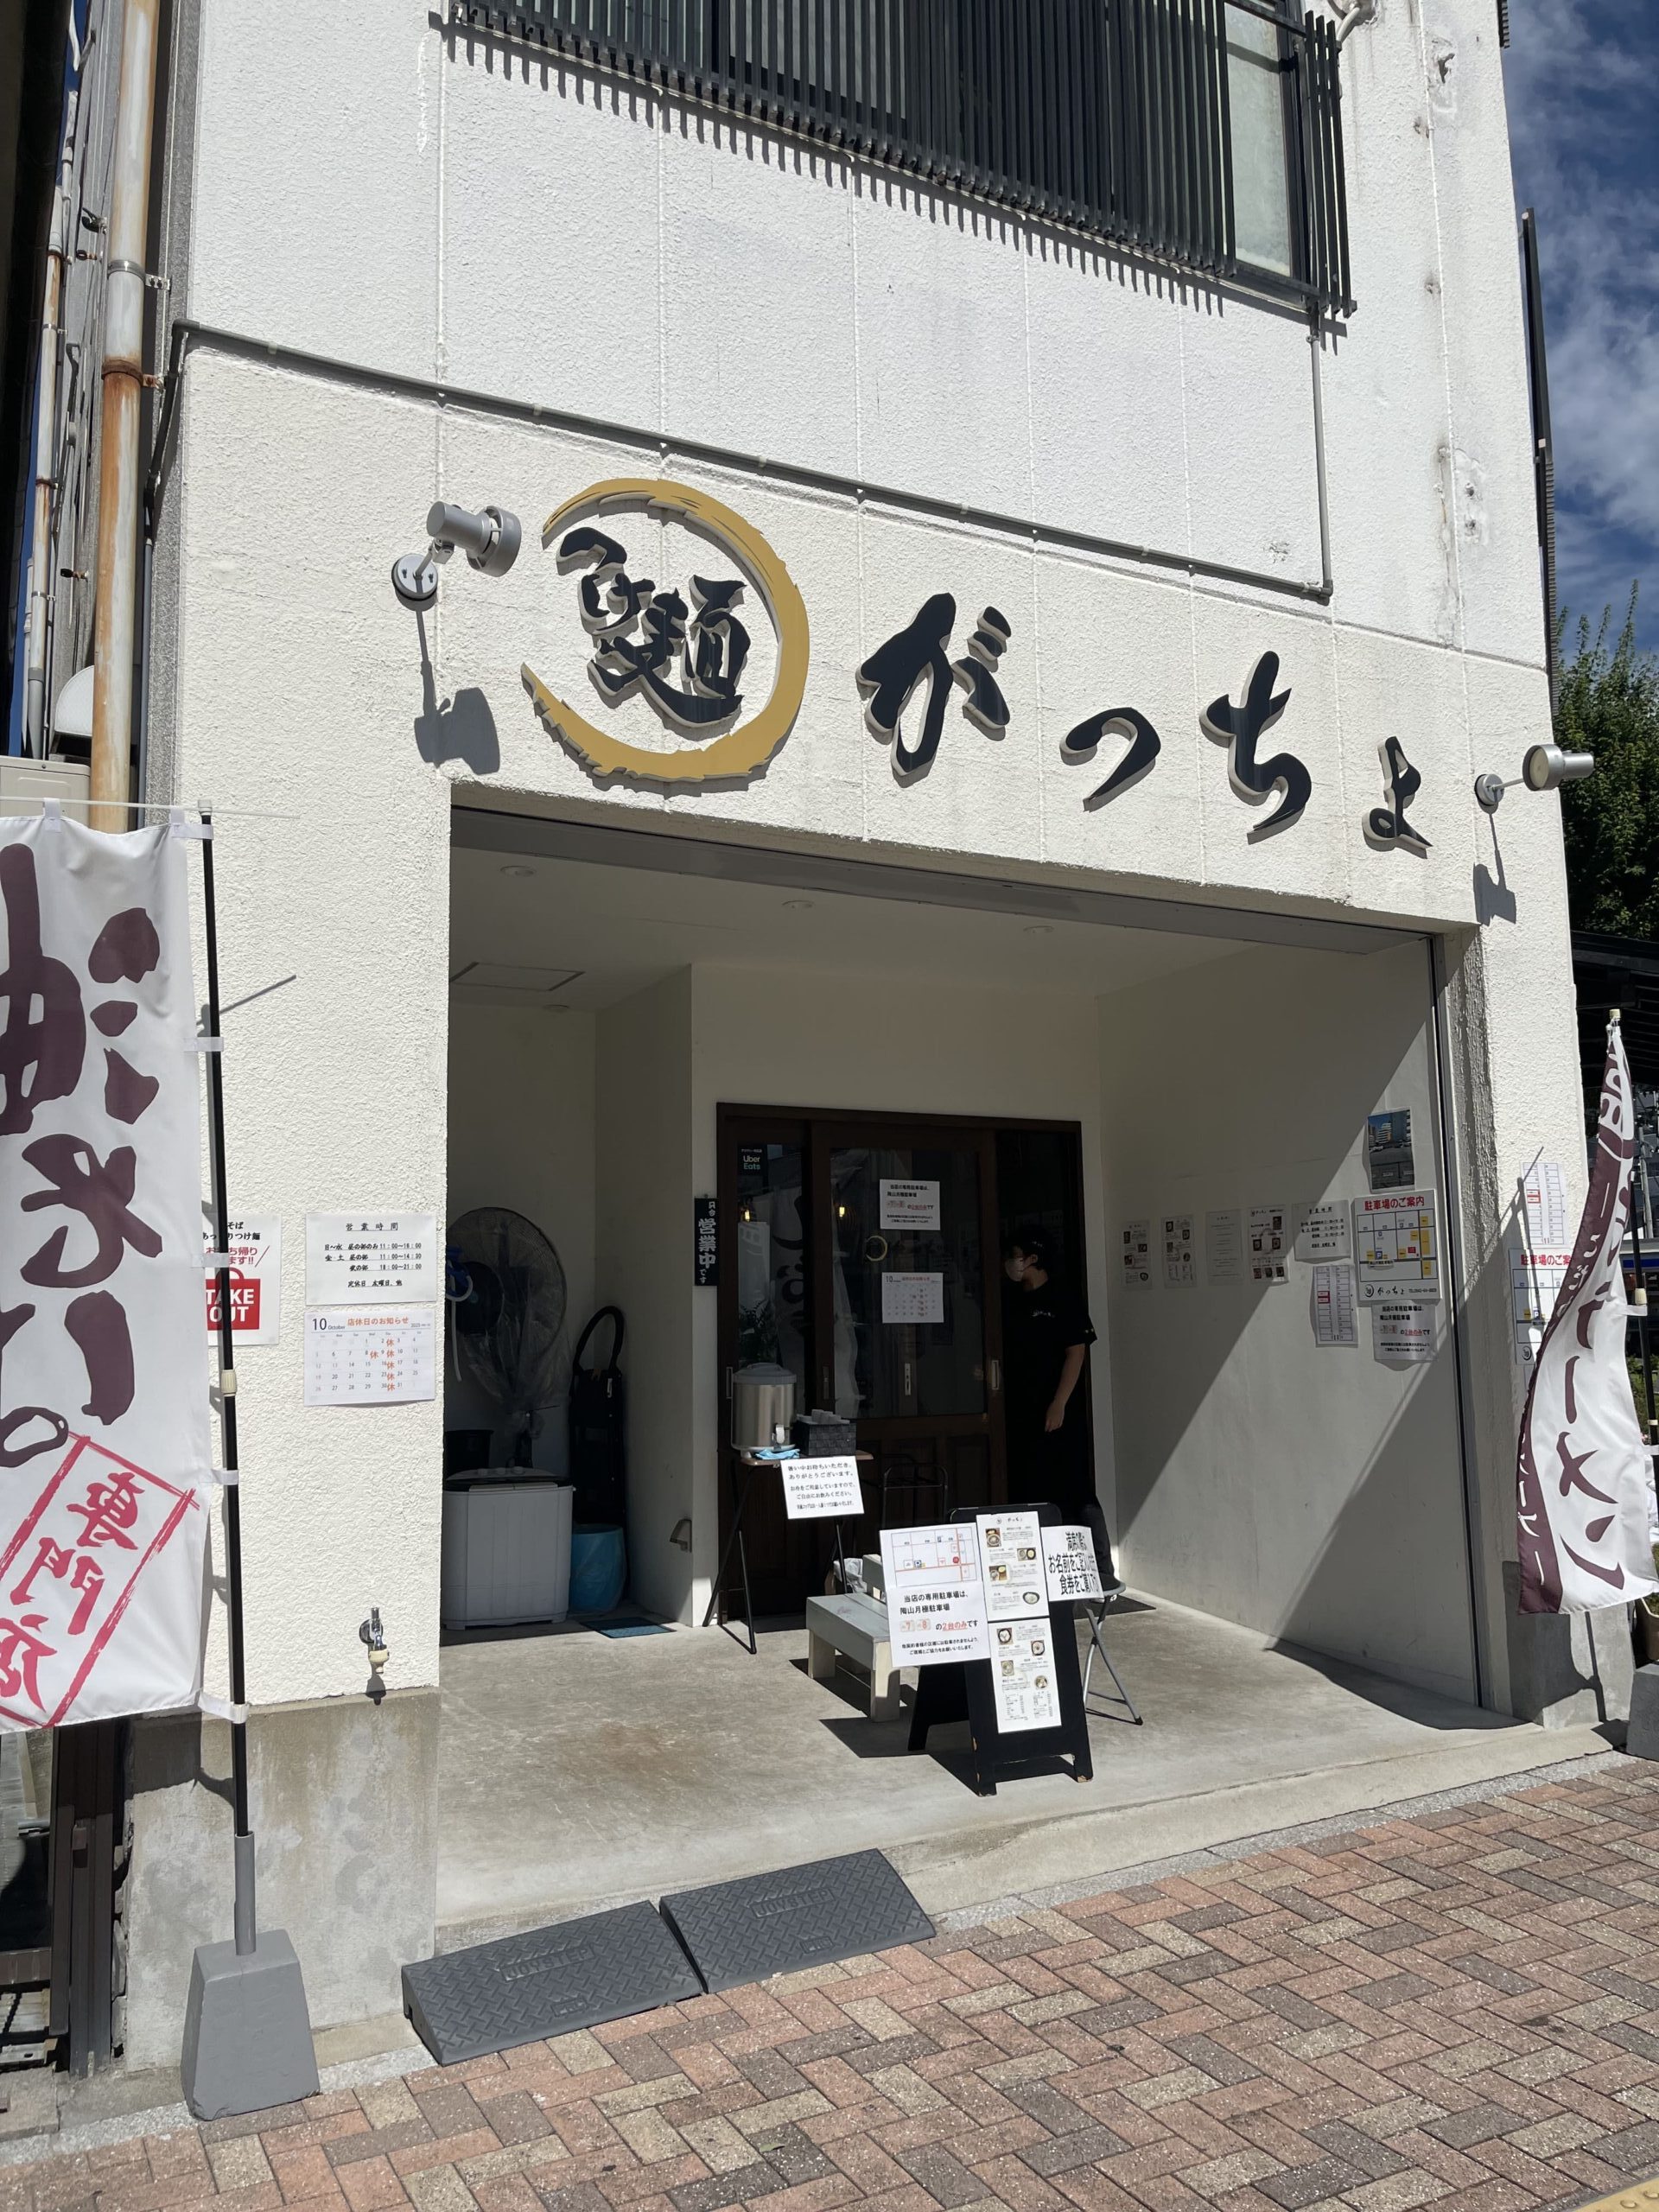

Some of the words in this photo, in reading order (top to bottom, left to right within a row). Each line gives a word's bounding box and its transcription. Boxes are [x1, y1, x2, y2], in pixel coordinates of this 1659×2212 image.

[557, 526, 751, 724] つけ麺
[856, 592, 1432, 849] がっちょ
[1364, 1196, 1425, 1211] 駐車場のご案内
[698, 1218, 717, 1268] 営業中
[1521, 1255, 1572, 1265] 駐車場のご案
[312, 1319, 327, 1331] 10
[347, 1316, 409, 1325] 店休日のお知らせ
[370, 1351, 378, 1359] 休
[387, 1350, 394, 1358] 休
[904, 1591, 969, 1602] 当店の専用駐車場は、
[936, 1620, 978, 1631] の2台のみです
[758, 1890, 828, 1915] JOYSTEP
[506, 1948, 588, 1979] JOYSTEP
